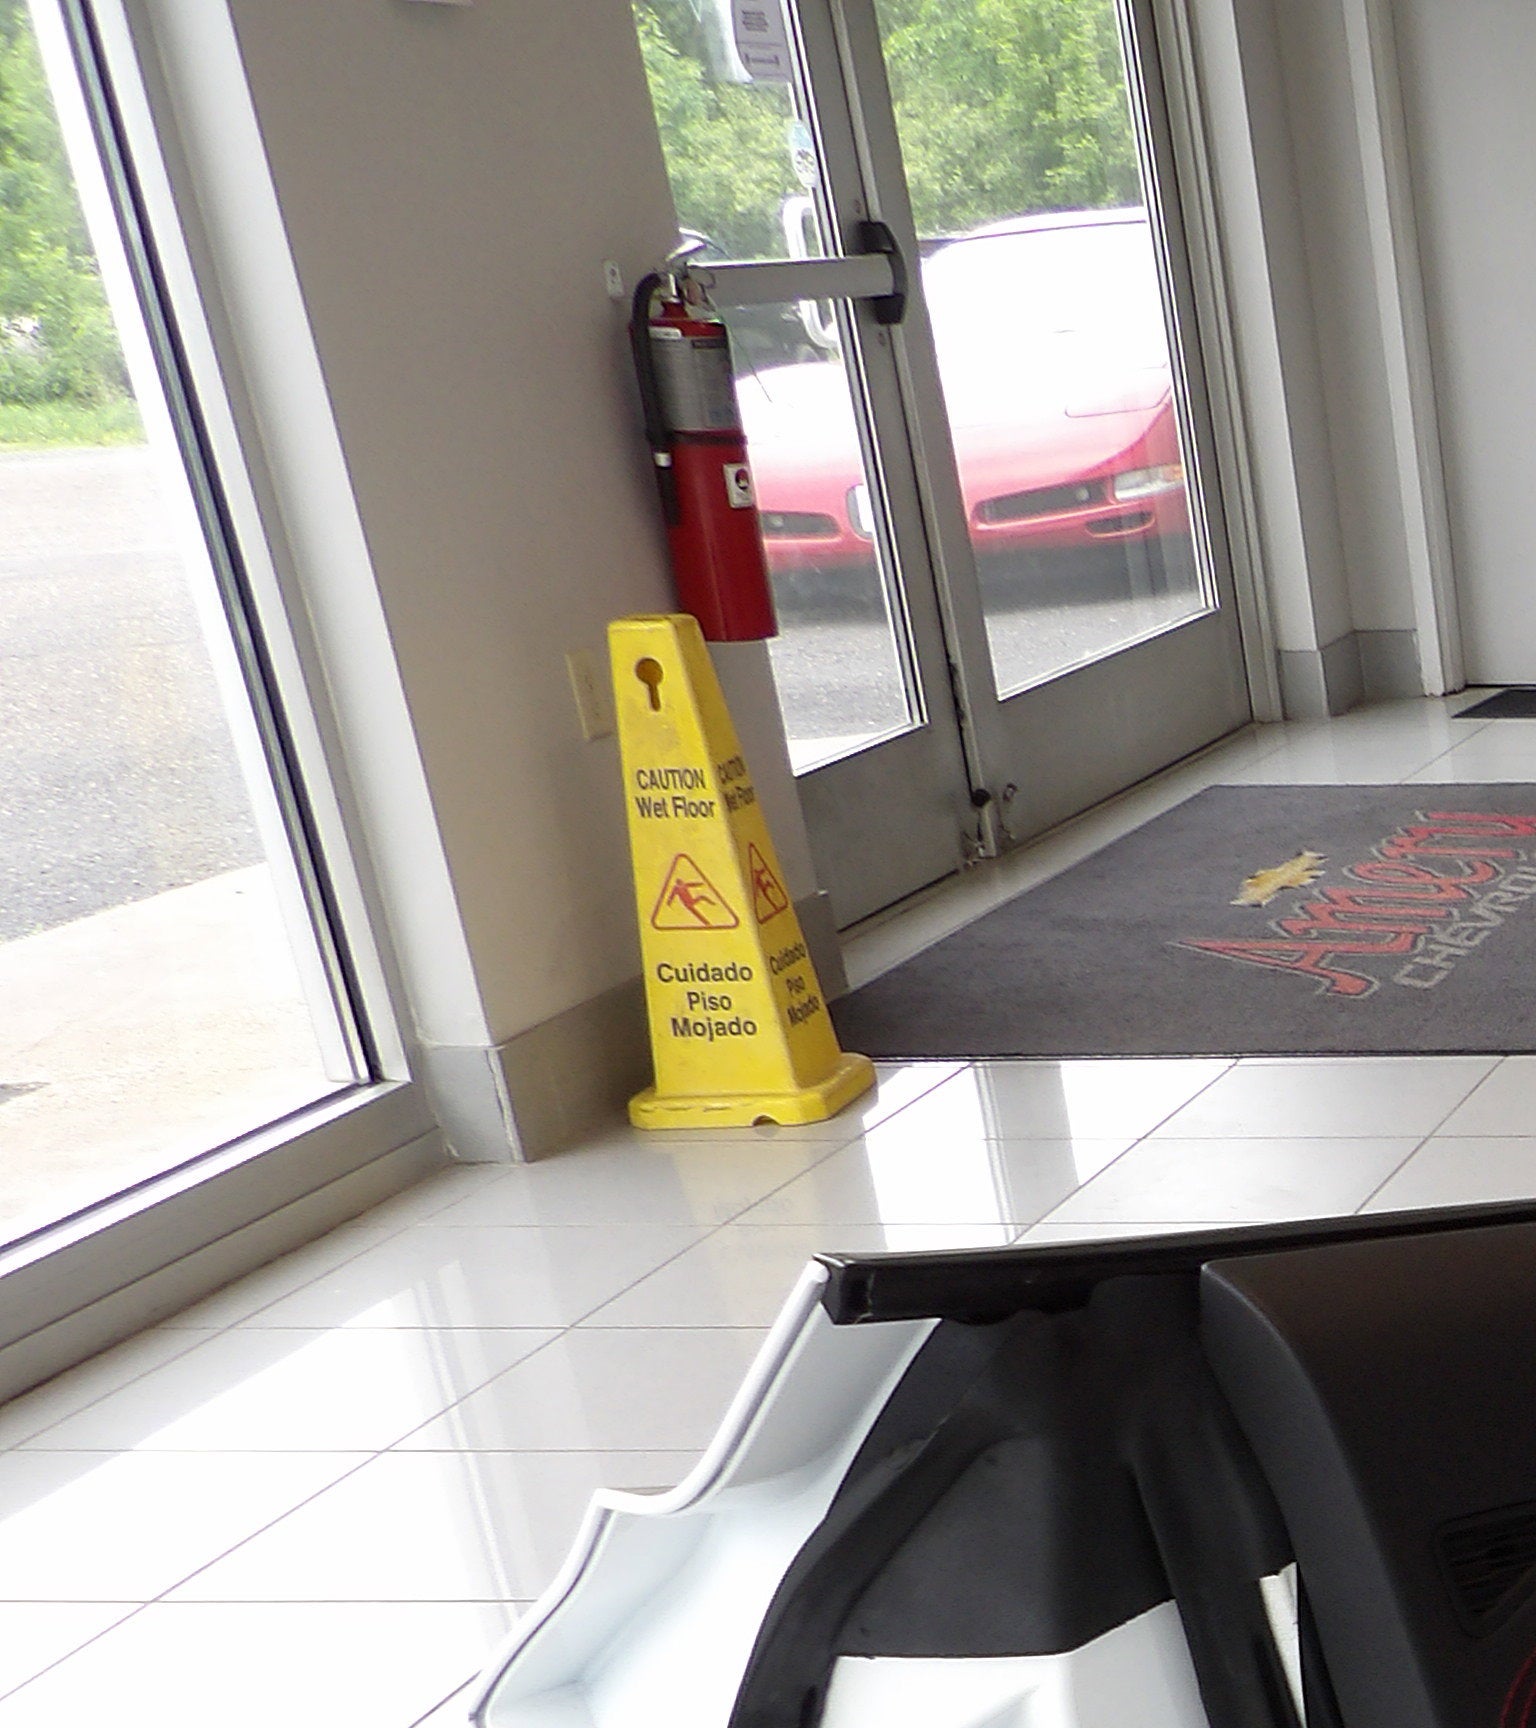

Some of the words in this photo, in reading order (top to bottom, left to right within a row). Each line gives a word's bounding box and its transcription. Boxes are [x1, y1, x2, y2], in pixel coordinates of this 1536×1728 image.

[636, 768, 706, 790] CAUTION
[634, 796, 669, 818] Wet
[672, 796, 716, 818] Floor
[656, 962, 753, 983] Cuidado
[687, 991, 732, 1011] Piso
[670, 1016, 757, 1042] Mojado
